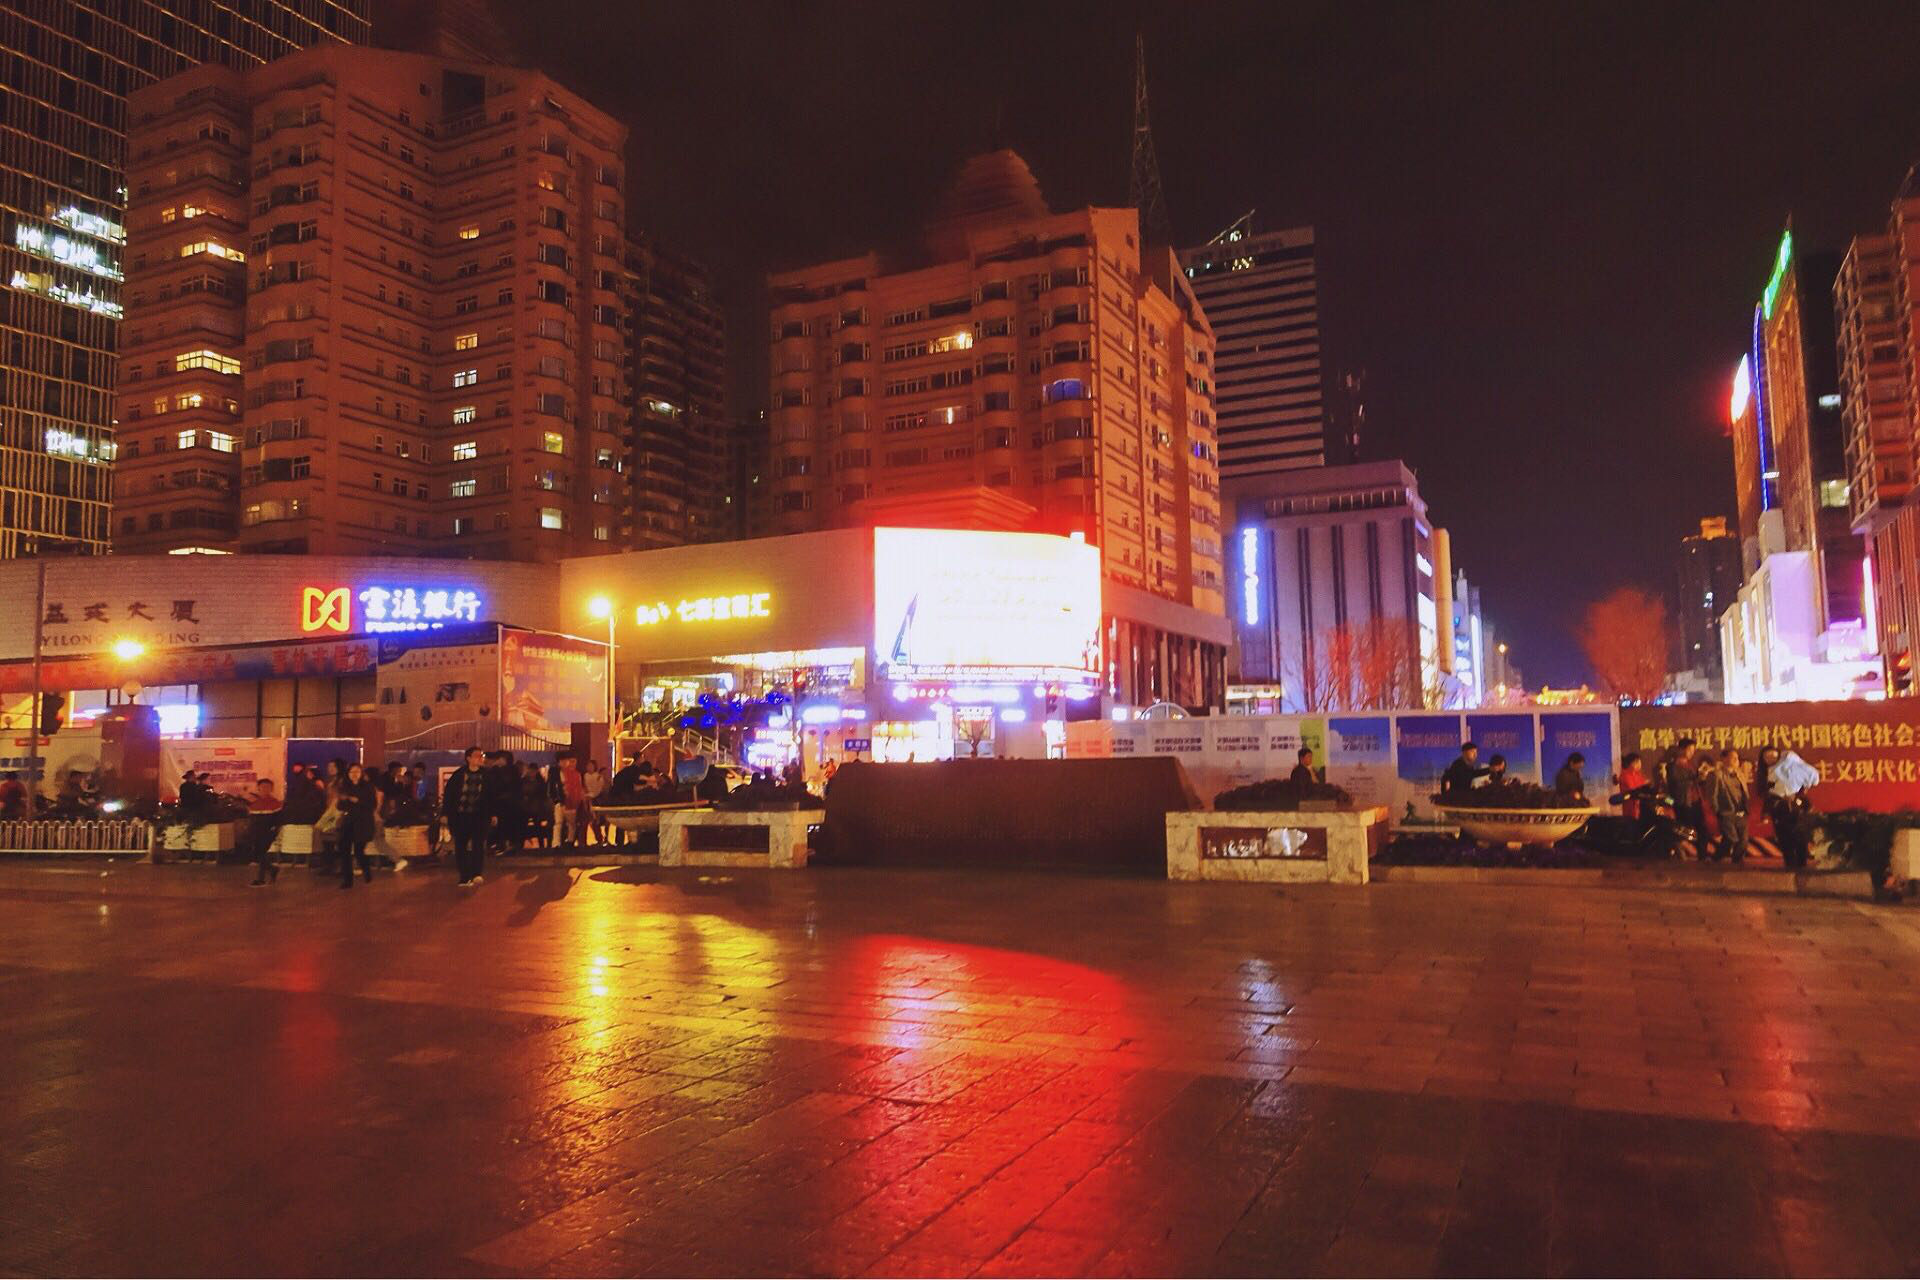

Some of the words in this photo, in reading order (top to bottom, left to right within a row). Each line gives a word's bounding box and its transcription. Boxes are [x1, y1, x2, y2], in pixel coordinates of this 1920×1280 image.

[1639, 722, 1920, 751] 高举习近平新时代中国特色社会
